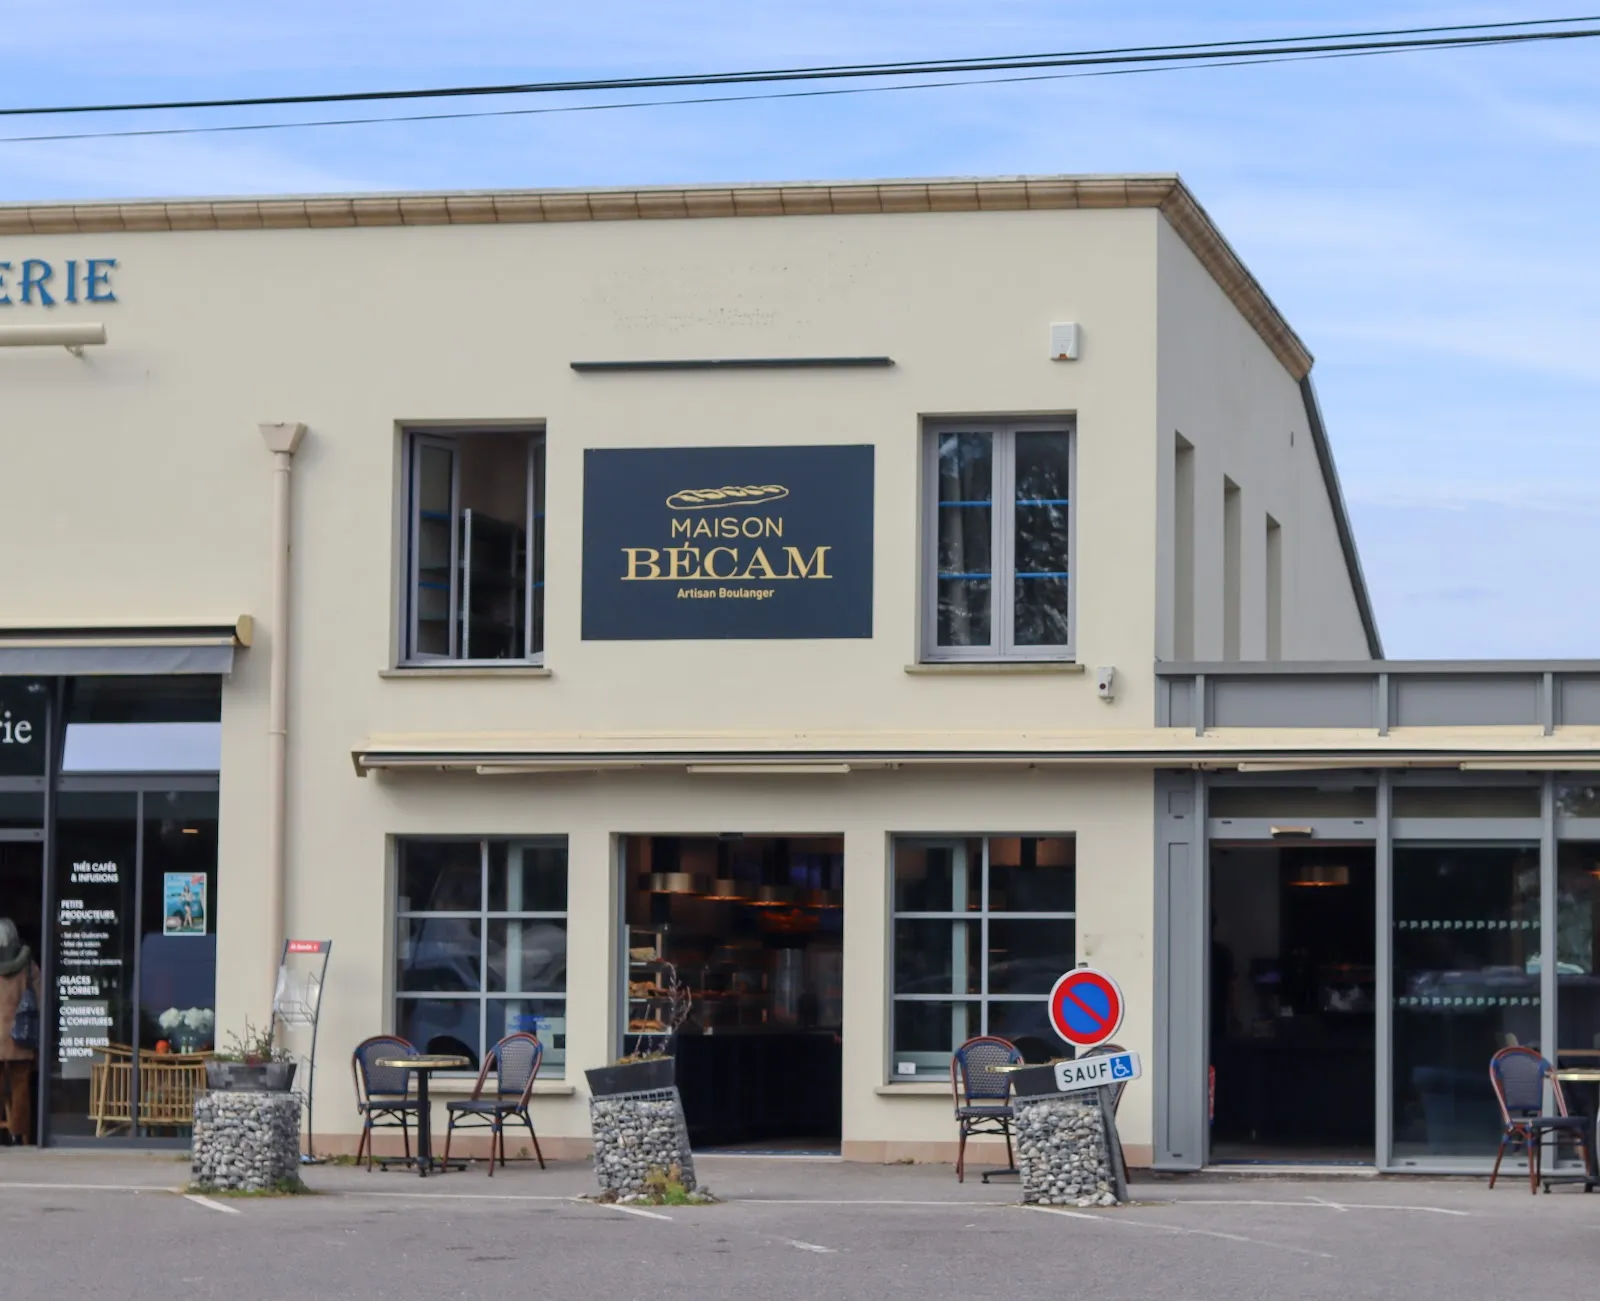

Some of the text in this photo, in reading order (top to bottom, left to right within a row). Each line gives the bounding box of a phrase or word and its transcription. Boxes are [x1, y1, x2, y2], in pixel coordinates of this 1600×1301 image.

[671, 517, 783, 538] MAISON
[620, 541, 833, 580] BÉCAM
[677, 588, 775, 600] Artisan Boulanger
[0, 710, 32, 744] ie
[73, 861, 117, 872] THÉS CAFÉS
[78, 873, 119, 883] INFUSIONS
[61, 900, 84, 909] PETITS
[61, 910, 115, 920] PRODUCTEURS
[60, 975, 91, 985] GLACES
[67, 986, 99, 996] SORBETS
[59, 1006, 105, 1016] CONSERVES
[67, 1016, 114, 1026] CONFITURES
[59, 1037, 110, 1047] JUS DE FRUITS
[66, 1047, 94, 1057] SIROPS
[1063, 1062, 1107, 1083] SAUF
